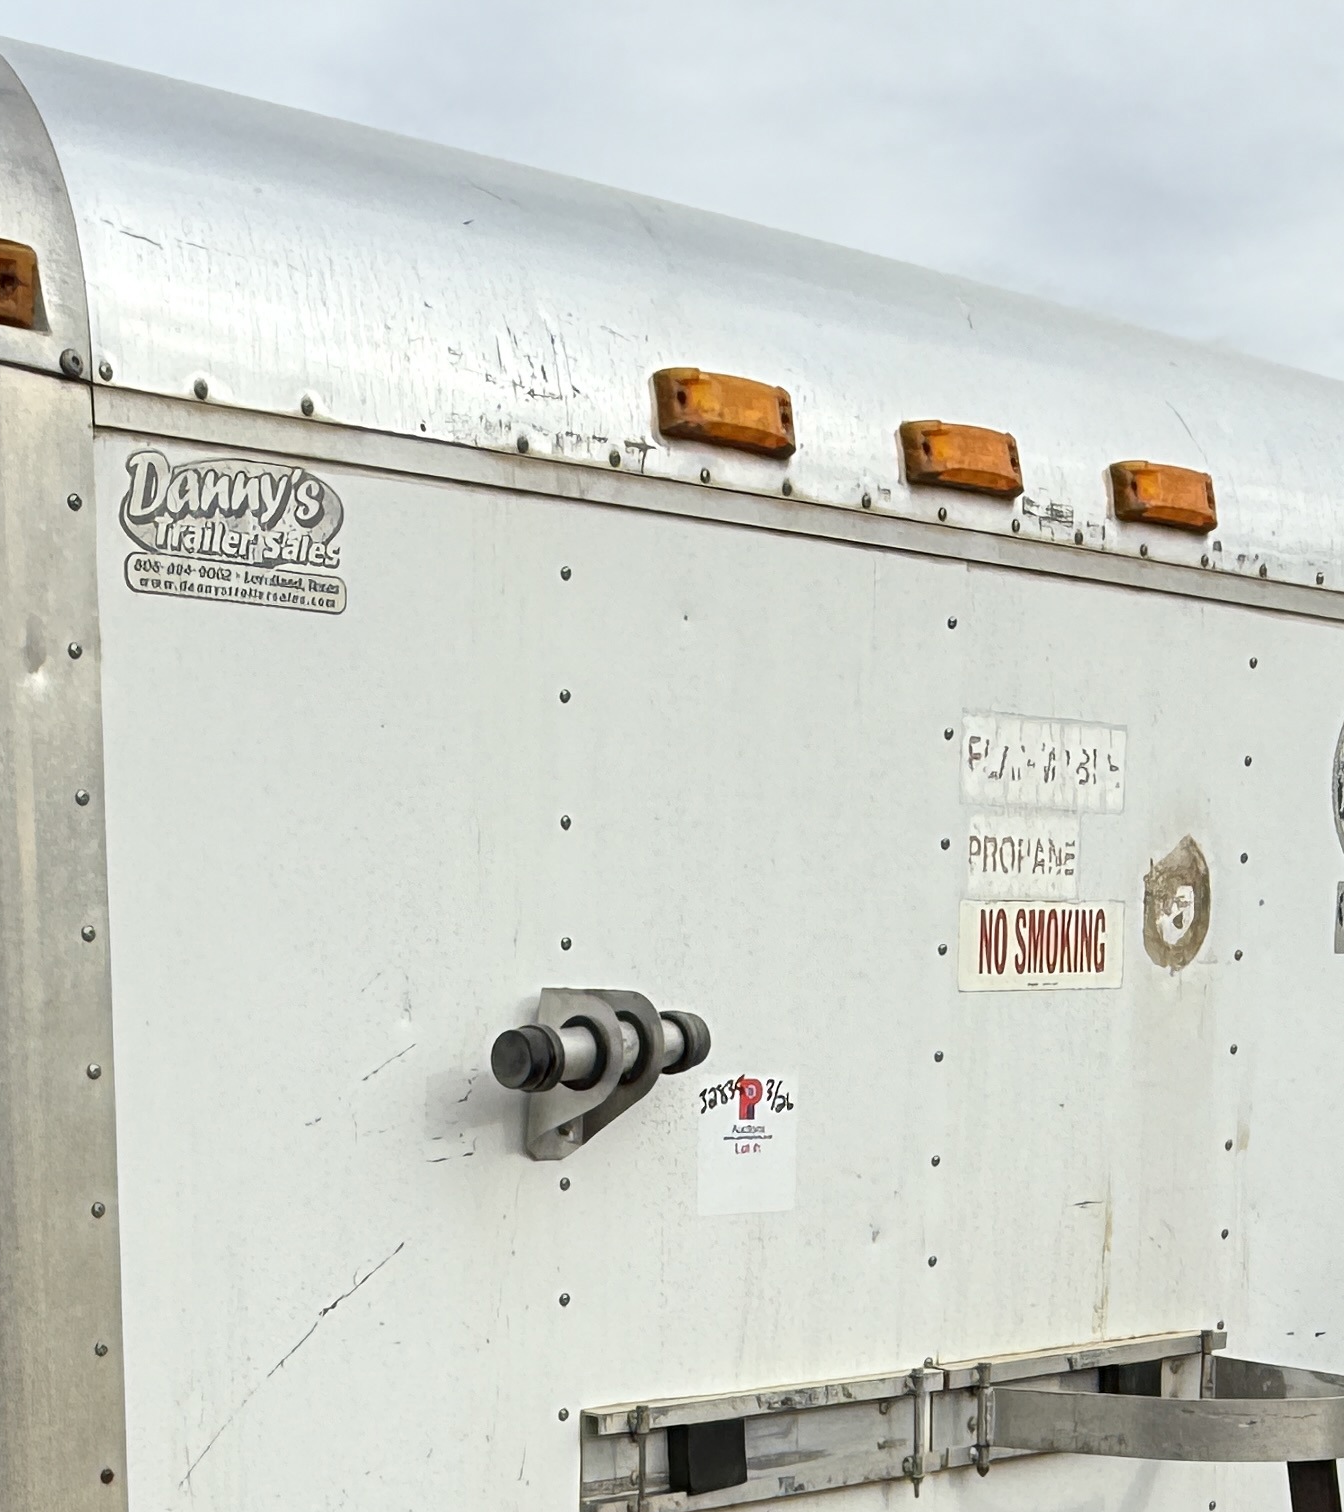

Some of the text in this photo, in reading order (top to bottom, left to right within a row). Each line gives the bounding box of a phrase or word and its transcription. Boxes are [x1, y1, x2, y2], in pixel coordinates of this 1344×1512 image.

[126, 451, 325, 530] Danny's
[155, 514, 341, 569] Trailer Sales
[978, 908, 1106, 975] NO SMOKING
